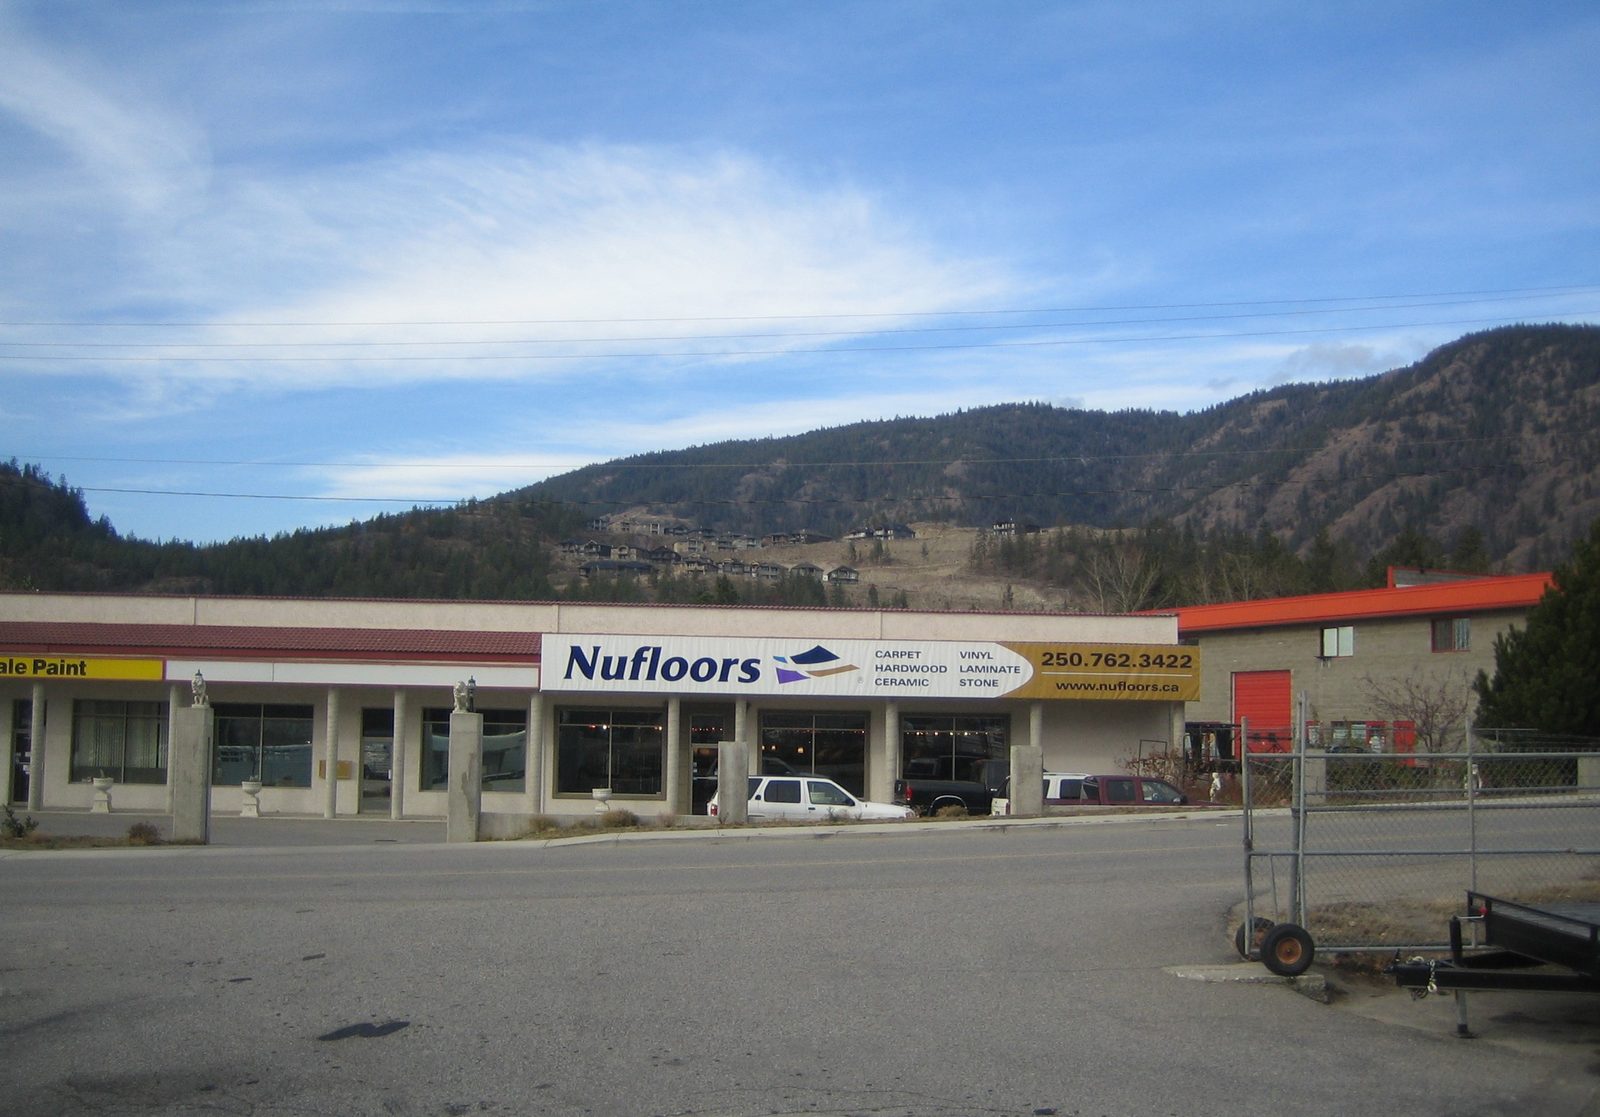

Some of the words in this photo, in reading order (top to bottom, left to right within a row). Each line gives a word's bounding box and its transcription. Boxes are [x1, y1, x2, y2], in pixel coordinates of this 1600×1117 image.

[875, 650, 922, 659] CARPET
[959, 651, 994, 660] VINYL
[564, 645, 761, 684] Nufloors
[1041, 652, 1193, 669] 250.762.3422
[33, 659, 87, 676] Paint
[875, 664, 948, 673] HARDWOOD
[959, 665, 1021, 674] LAMINATE
[875, 678, 930, 687] CERAMIC
[959, 678, 999, 687] STONE
[1056, 681, 1179, 692] www.nufloors.ca
